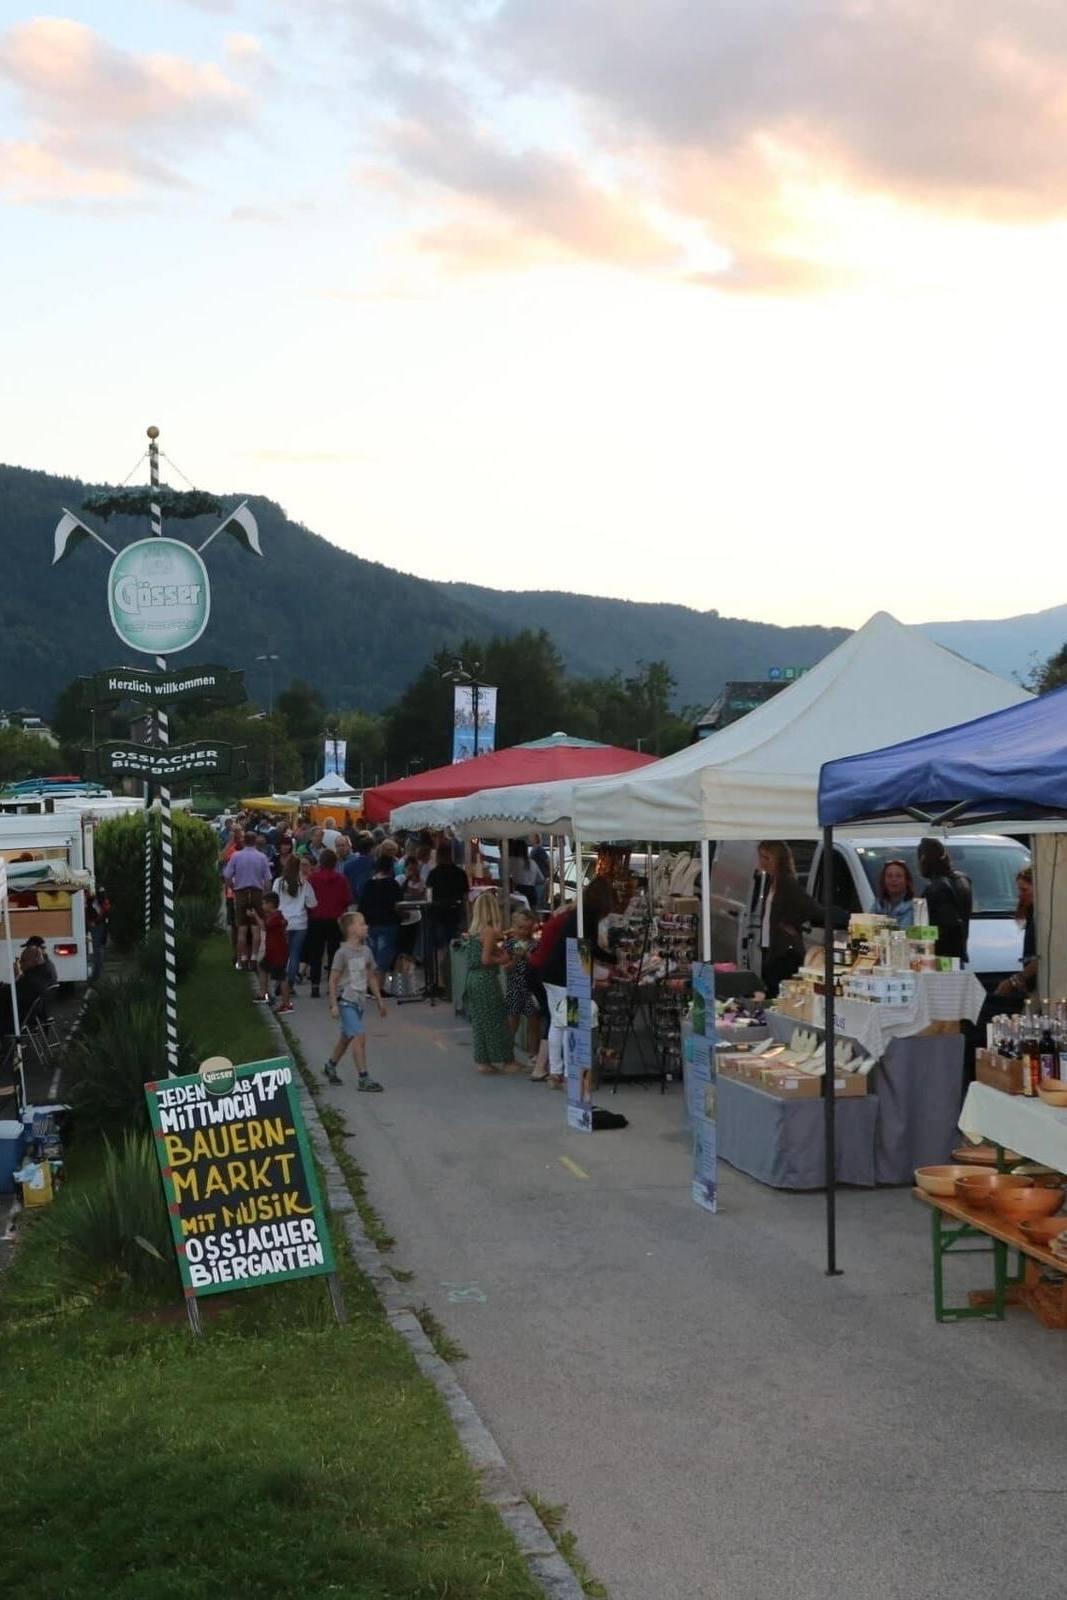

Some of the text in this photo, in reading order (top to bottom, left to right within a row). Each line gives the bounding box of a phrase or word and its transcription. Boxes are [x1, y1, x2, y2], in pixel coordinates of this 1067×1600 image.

[114, 574, 202, 614] Gösser
[108, 676, 216, 695] Herzlich willkommen
[111, 750, 219, 765] OSSIACHER
[112, 760, 217, 775] Biergarten
[156, 1082, 207, 1108] JEDEN
[231, 1079, 252, 1095] AB
[164, 1117, 296, 1168] BAUERN-
[171, 1153, 296, 1204] MARKT
